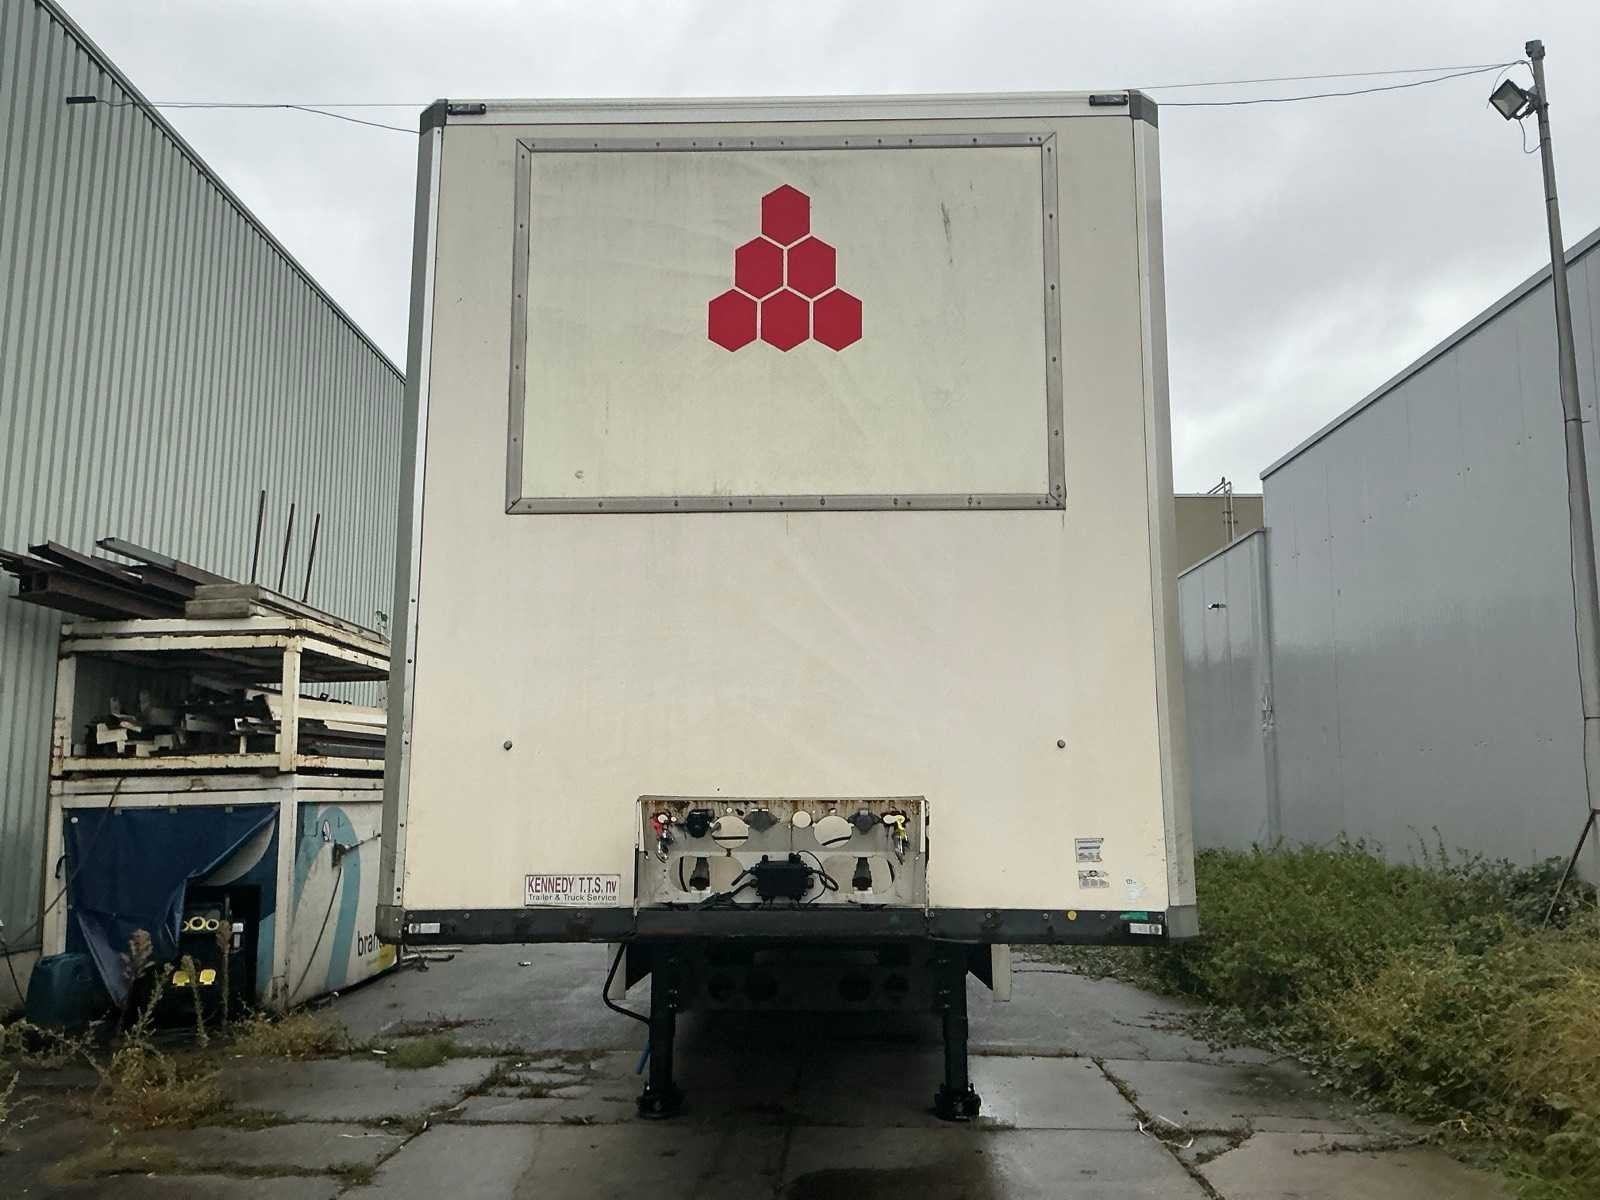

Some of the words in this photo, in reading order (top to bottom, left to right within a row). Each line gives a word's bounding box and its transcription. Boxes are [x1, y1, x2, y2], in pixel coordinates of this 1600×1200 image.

[528, 877, 574, 893] KENNEDY
[606, 880, 617, 893] nv
[587, 894, 617, 902] Service
